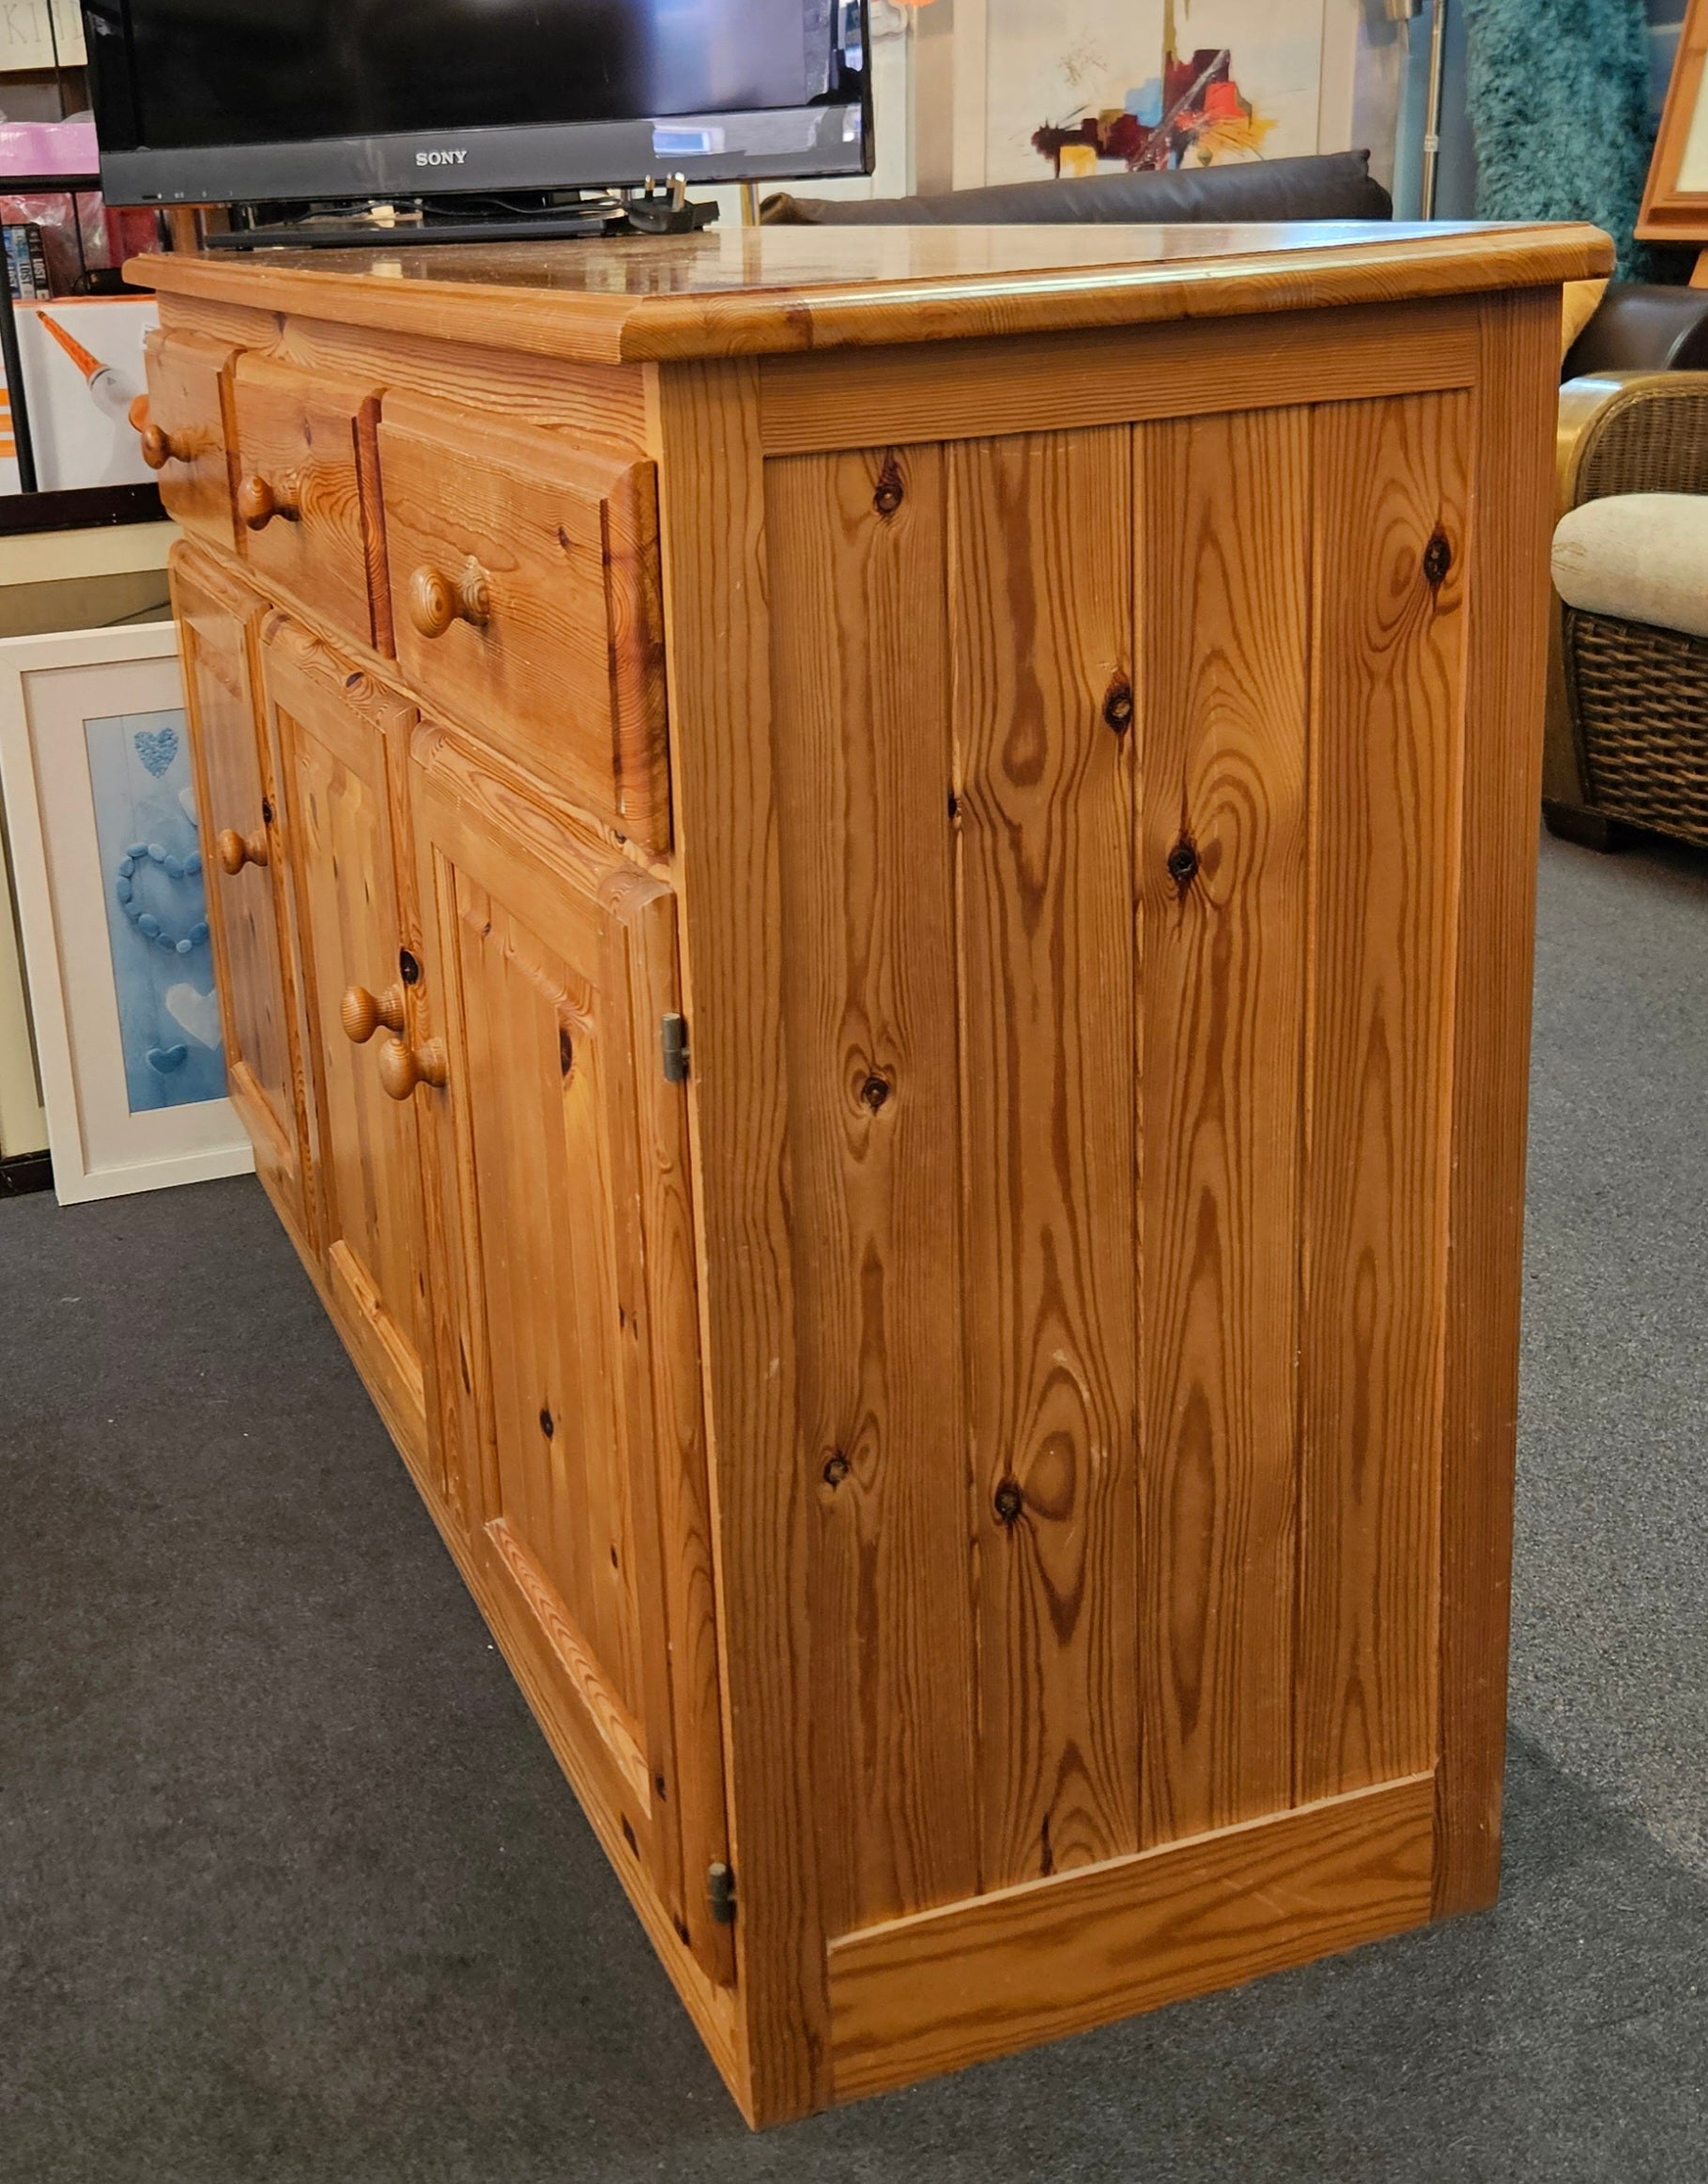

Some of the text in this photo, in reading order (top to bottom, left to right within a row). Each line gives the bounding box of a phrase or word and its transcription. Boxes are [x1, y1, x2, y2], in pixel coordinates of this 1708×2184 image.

[415, 149, 469, 166] SONY
[7, 266, 19, 288] LOST
[19, 263, 33, 285] LOST
[32, 258, 46, 280] LOST
